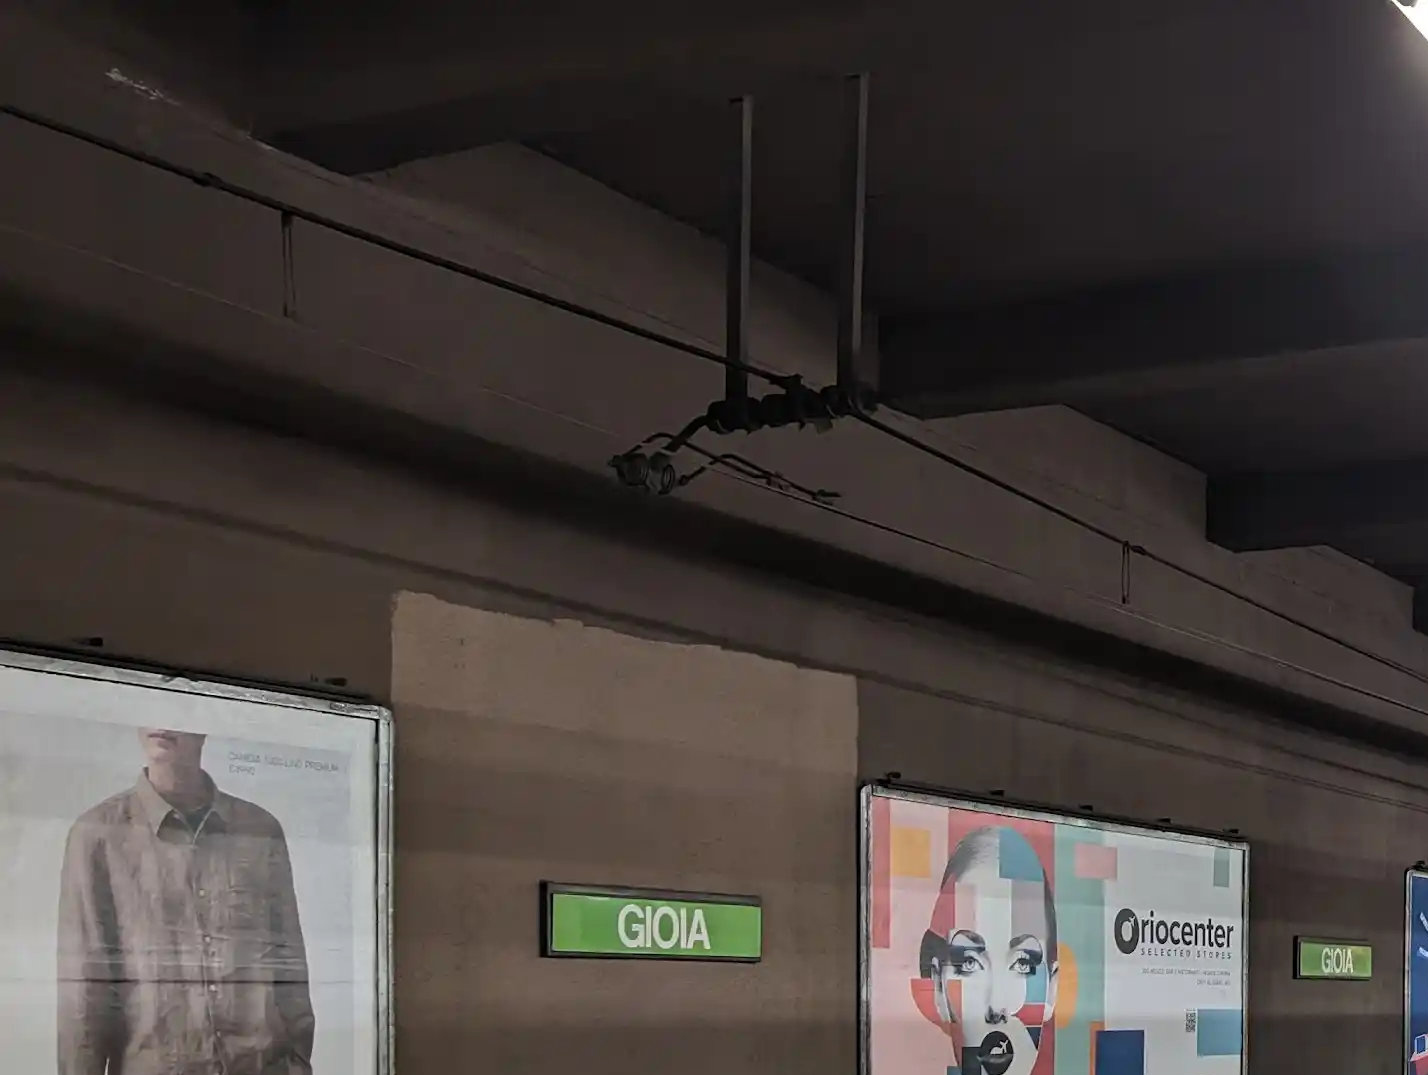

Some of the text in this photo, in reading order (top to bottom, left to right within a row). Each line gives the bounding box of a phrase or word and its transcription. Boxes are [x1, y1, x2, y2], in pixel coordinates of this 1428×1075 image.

[618, 904, 711, 949] GIOIA
[1114, 908, 1234, 954] Oriocenter
[1141, 947, 1232, 960] SELECTED STORES
[1321, 947, 1354, 974] GIOIA
